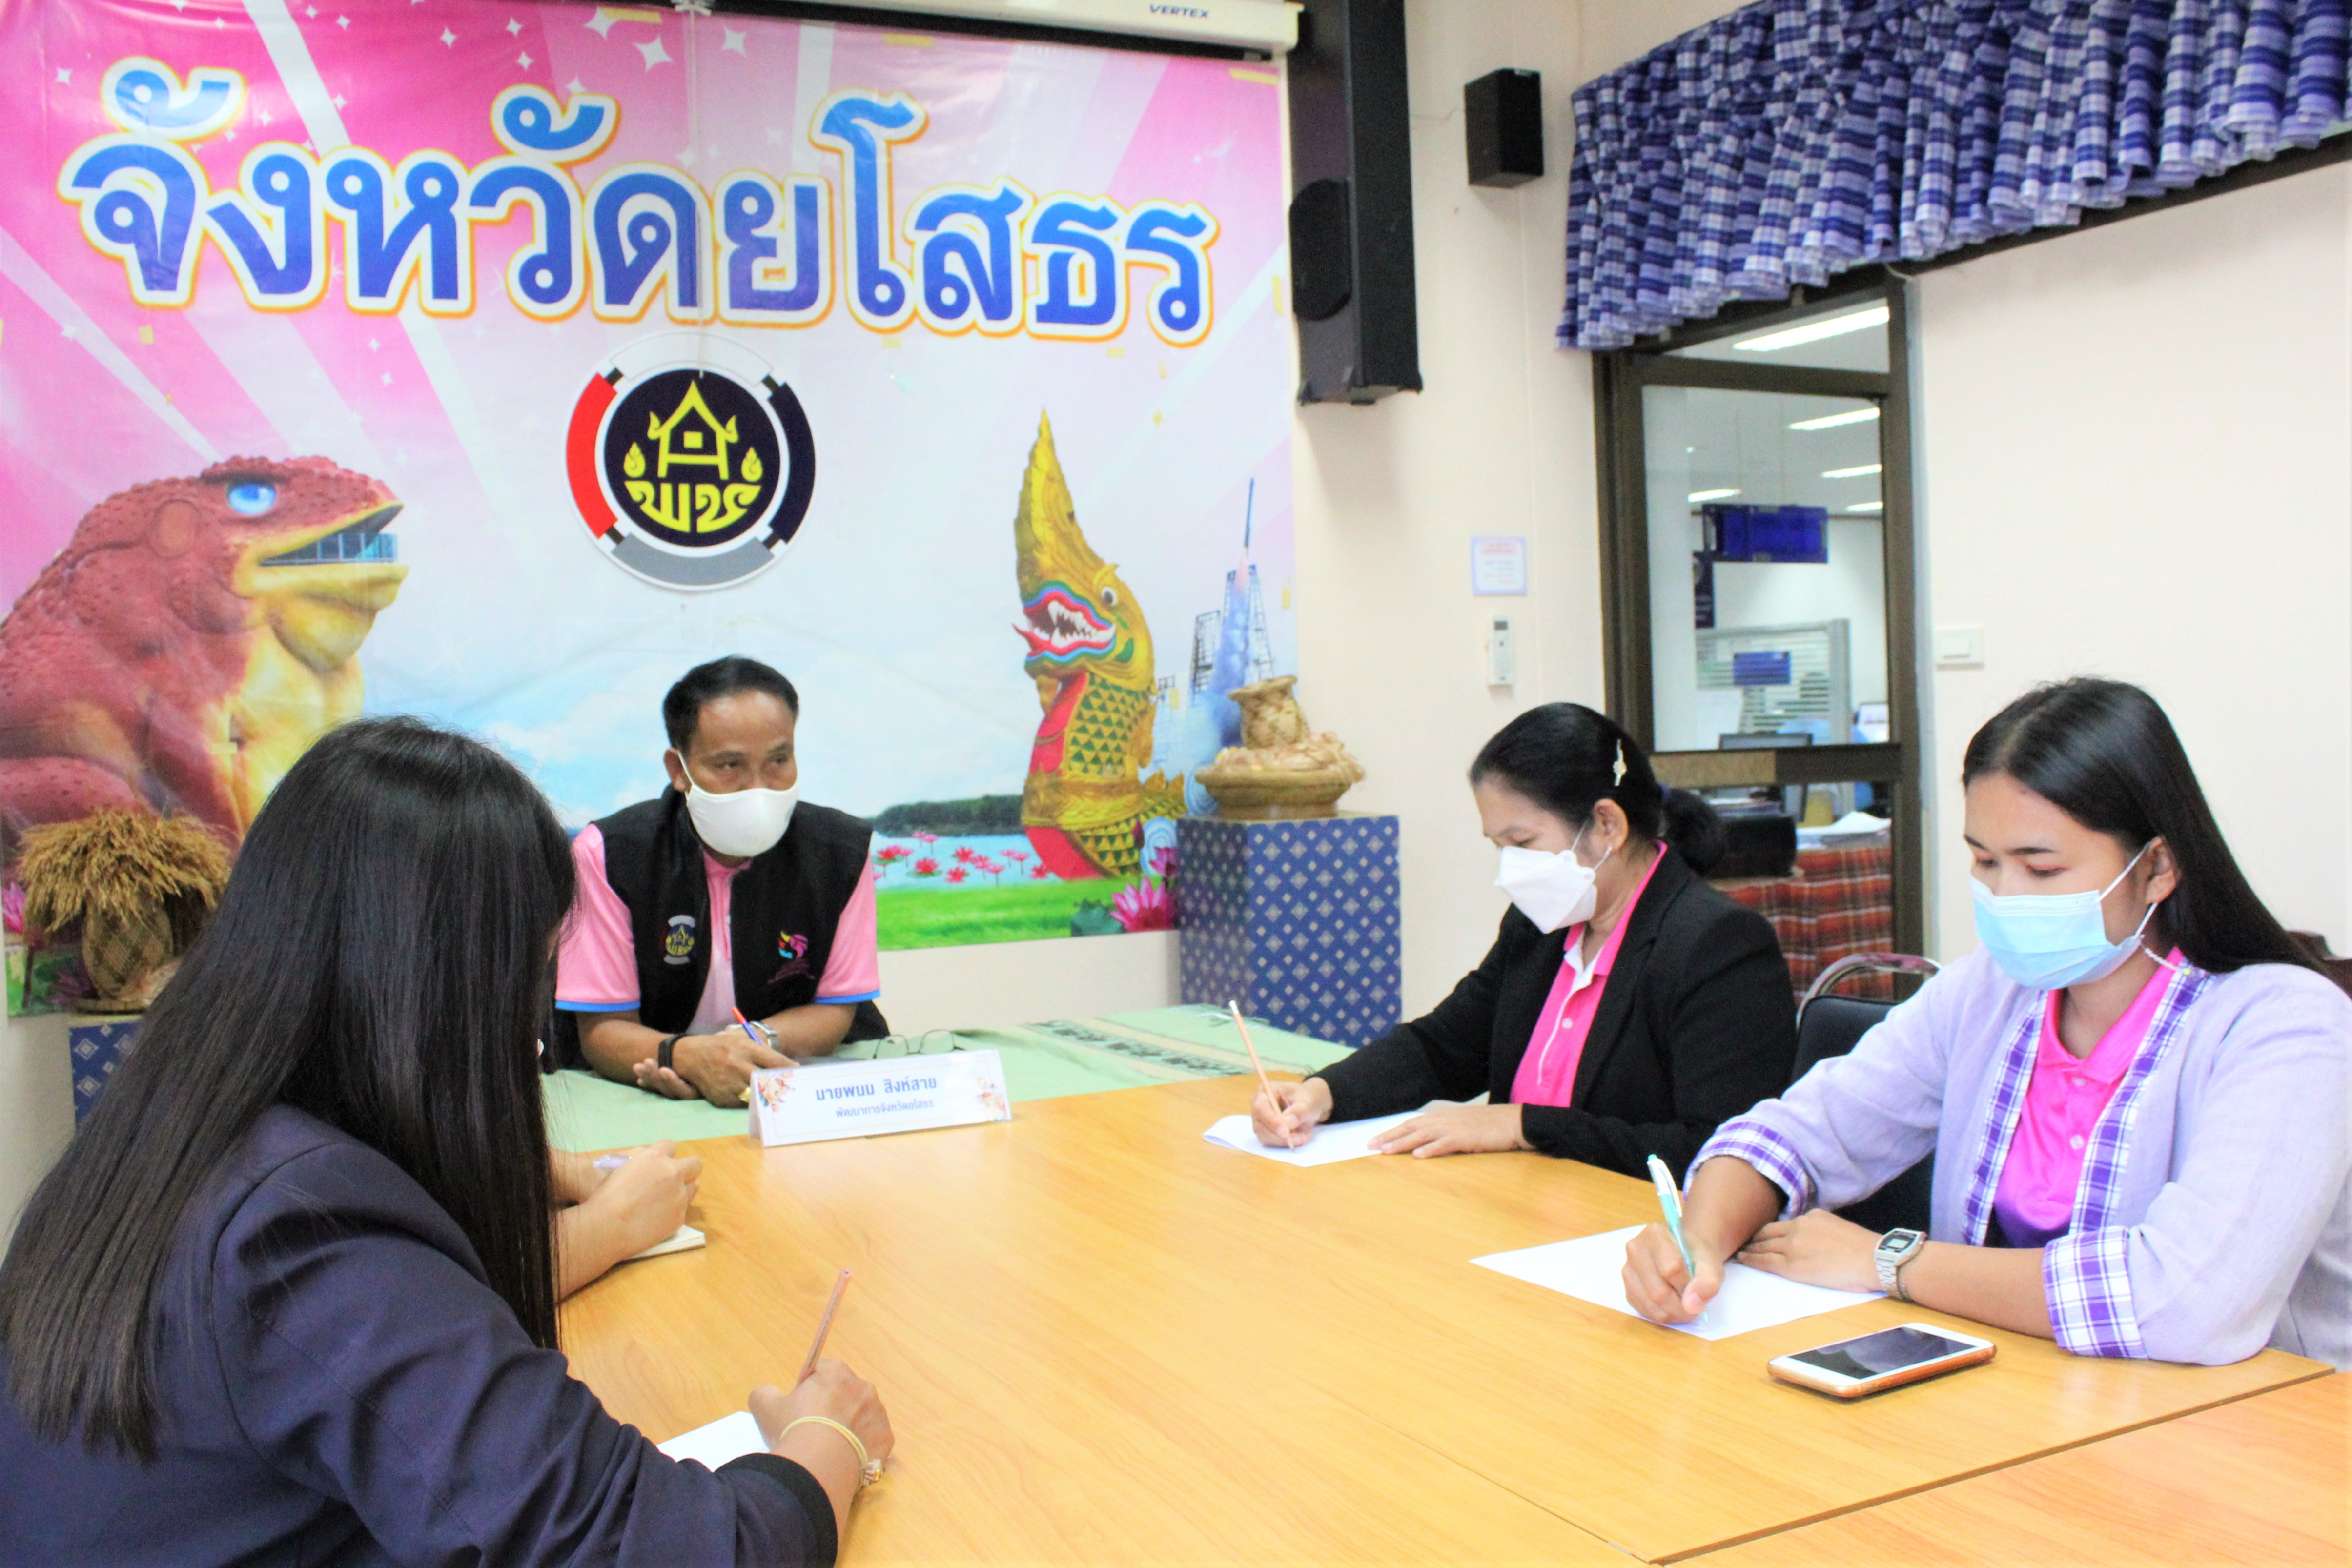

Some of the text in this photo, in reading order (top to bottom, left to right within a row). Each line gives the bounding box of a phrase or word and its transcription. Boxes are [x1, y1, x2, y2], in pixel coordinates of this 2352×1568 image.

[1150, 4, 1208, 18] VERTEX
[65, 63, 1213, 341] จังหวัดยโสธร
[816, 1076, 937, 1101] นายพนม สิงห์สาย
[835, 1099, 934, 1118] พัฒนาการจังหวัดยโสธร
